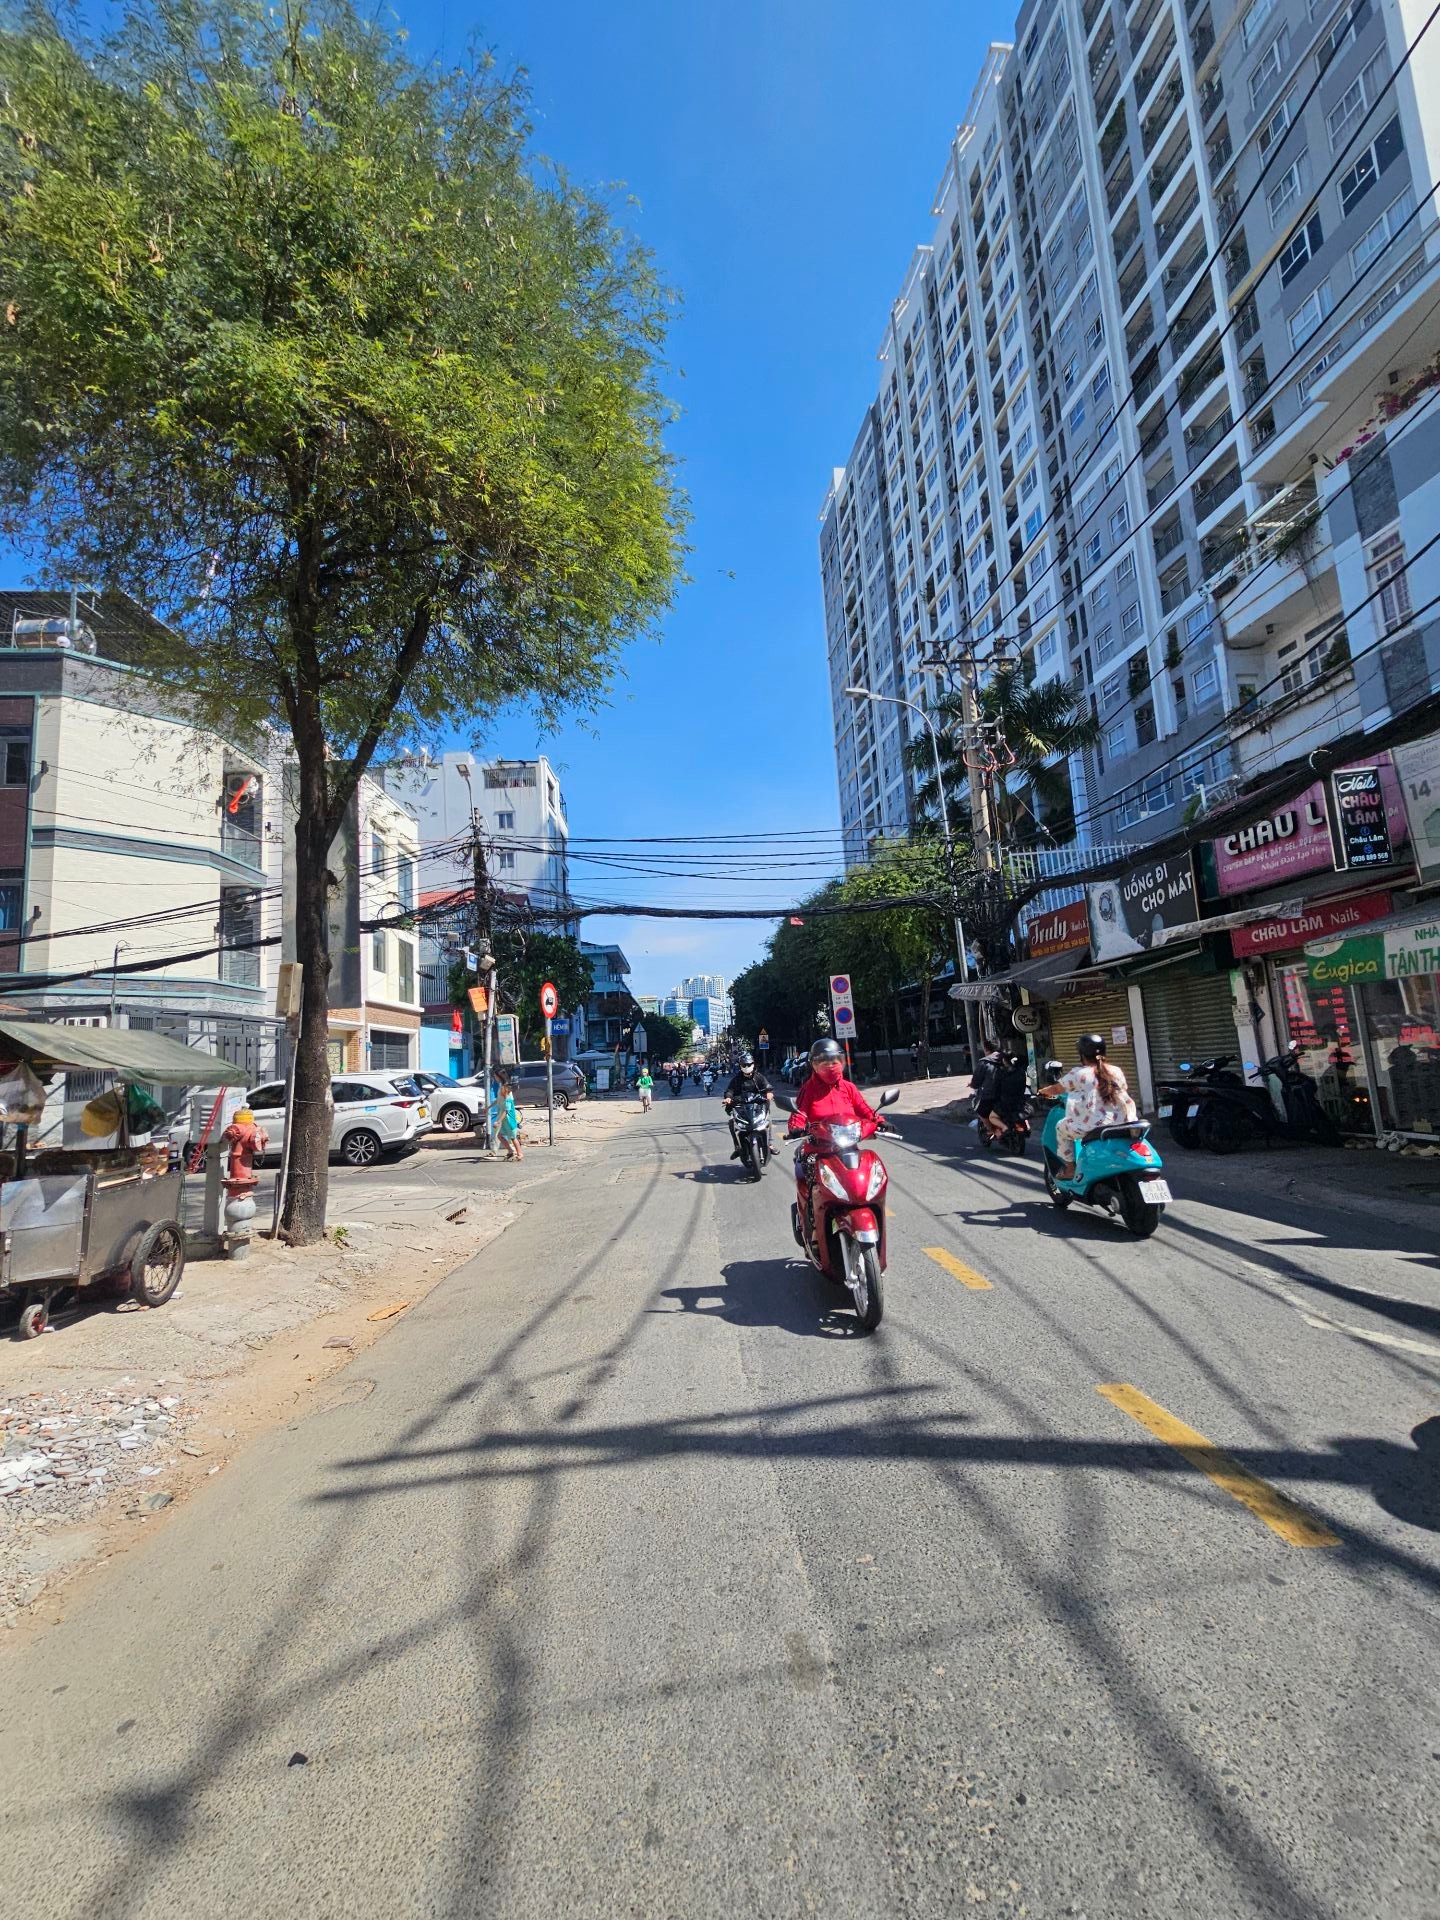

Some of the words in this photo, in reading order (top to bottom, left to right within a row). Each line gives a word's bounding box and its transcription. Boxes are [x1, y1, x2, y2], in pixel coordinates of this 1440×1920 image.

[1340, 775, 1377, 792] Nails
[1341, 791, 1380, 808] CHÂU
[1347, 809, 1378, 825] LÂM
[1124, 873, 1153, 901] UỐNG
[1156, 862, 1168, 883] ĐI
[1141, 888, 1165, 912] CHO
[1168, 872, 1192, 899] MÁT
[1331, 908, 1360, 925] Nails
[1312, 958, 1378, 982] Eugica
[1388, 946, 1419, 976] TÂN
